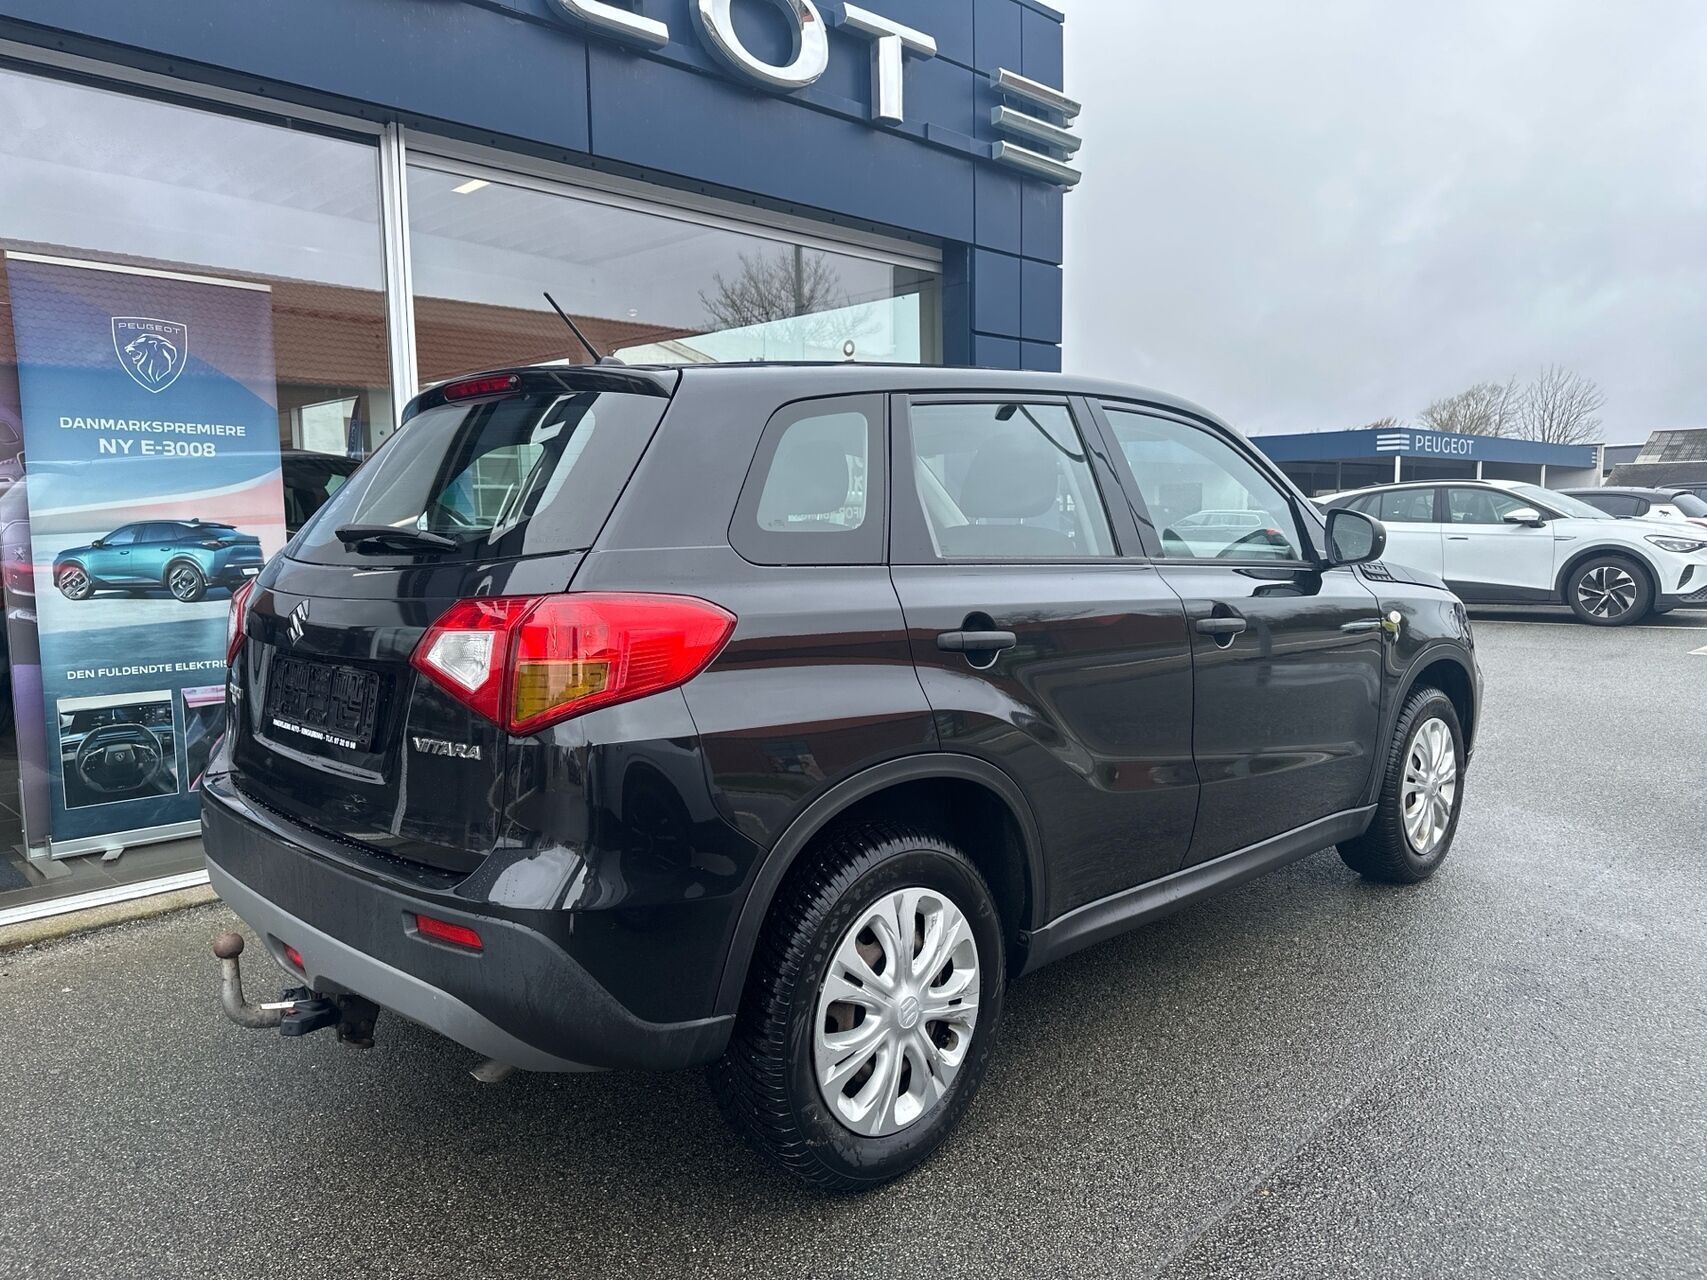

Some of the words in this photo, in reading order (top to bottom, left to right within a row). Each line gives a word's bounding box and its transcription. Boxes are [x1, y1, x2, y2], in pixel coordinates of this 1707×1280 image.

[118, 322, 181, 335] PEUGEOT
[59, 417, 246, 437] DANMARKSPREMIERE
[99, 438, 132, 455] NY
[141, 440, 216, 457] E-3008
[1415, 434, 1475, 455] PEUGEOT
[67, 669, 95, 680] DEN
[98, 664, 173, 678] FULDENDTE
[412, 736, 481, 761] VITARA
